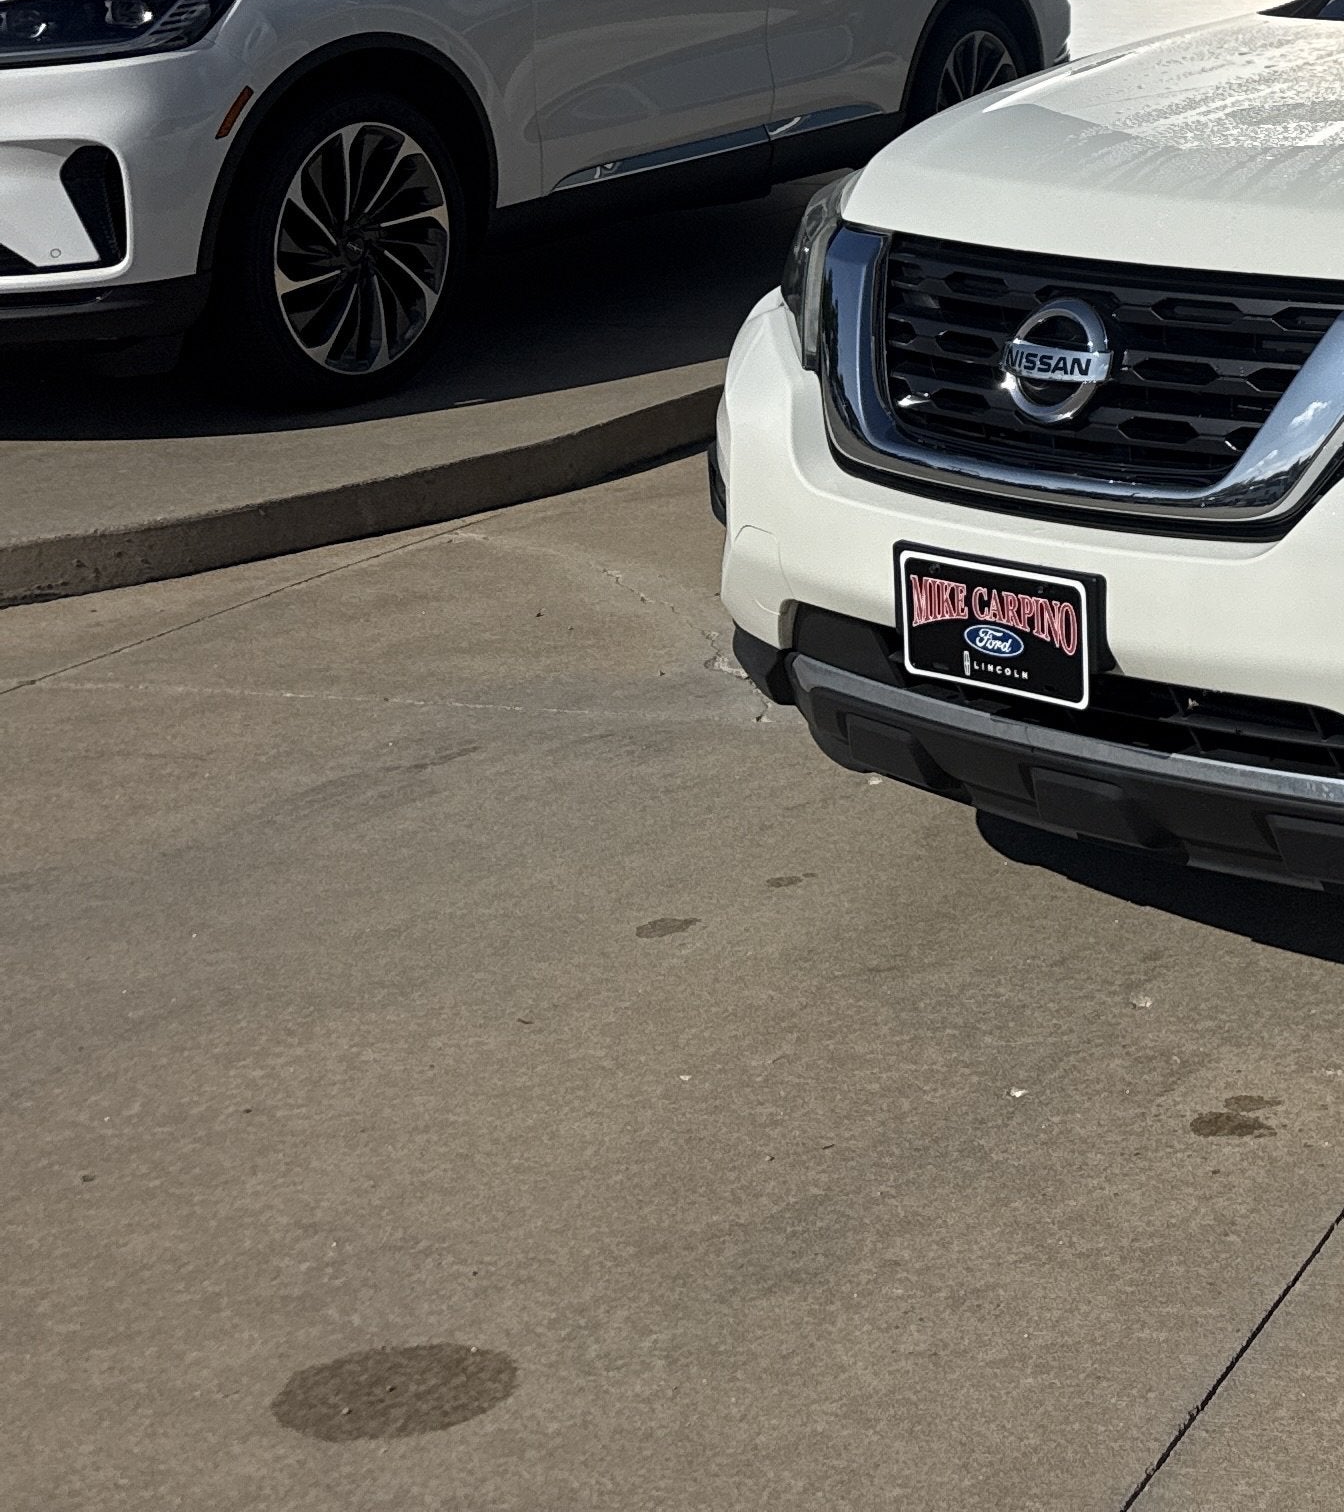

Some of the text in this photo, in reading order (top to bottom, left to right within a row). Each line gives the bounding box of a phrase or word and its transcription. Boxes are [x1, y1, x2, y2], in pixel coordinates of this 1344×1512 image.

[1005, 348, 1092, 376] NISSAN
[910, 574, 1078, 656] MIKE CARPINO
[975, 628, 1013, 653] Ford
[973, 660, 1029, 680] LINCOLN
